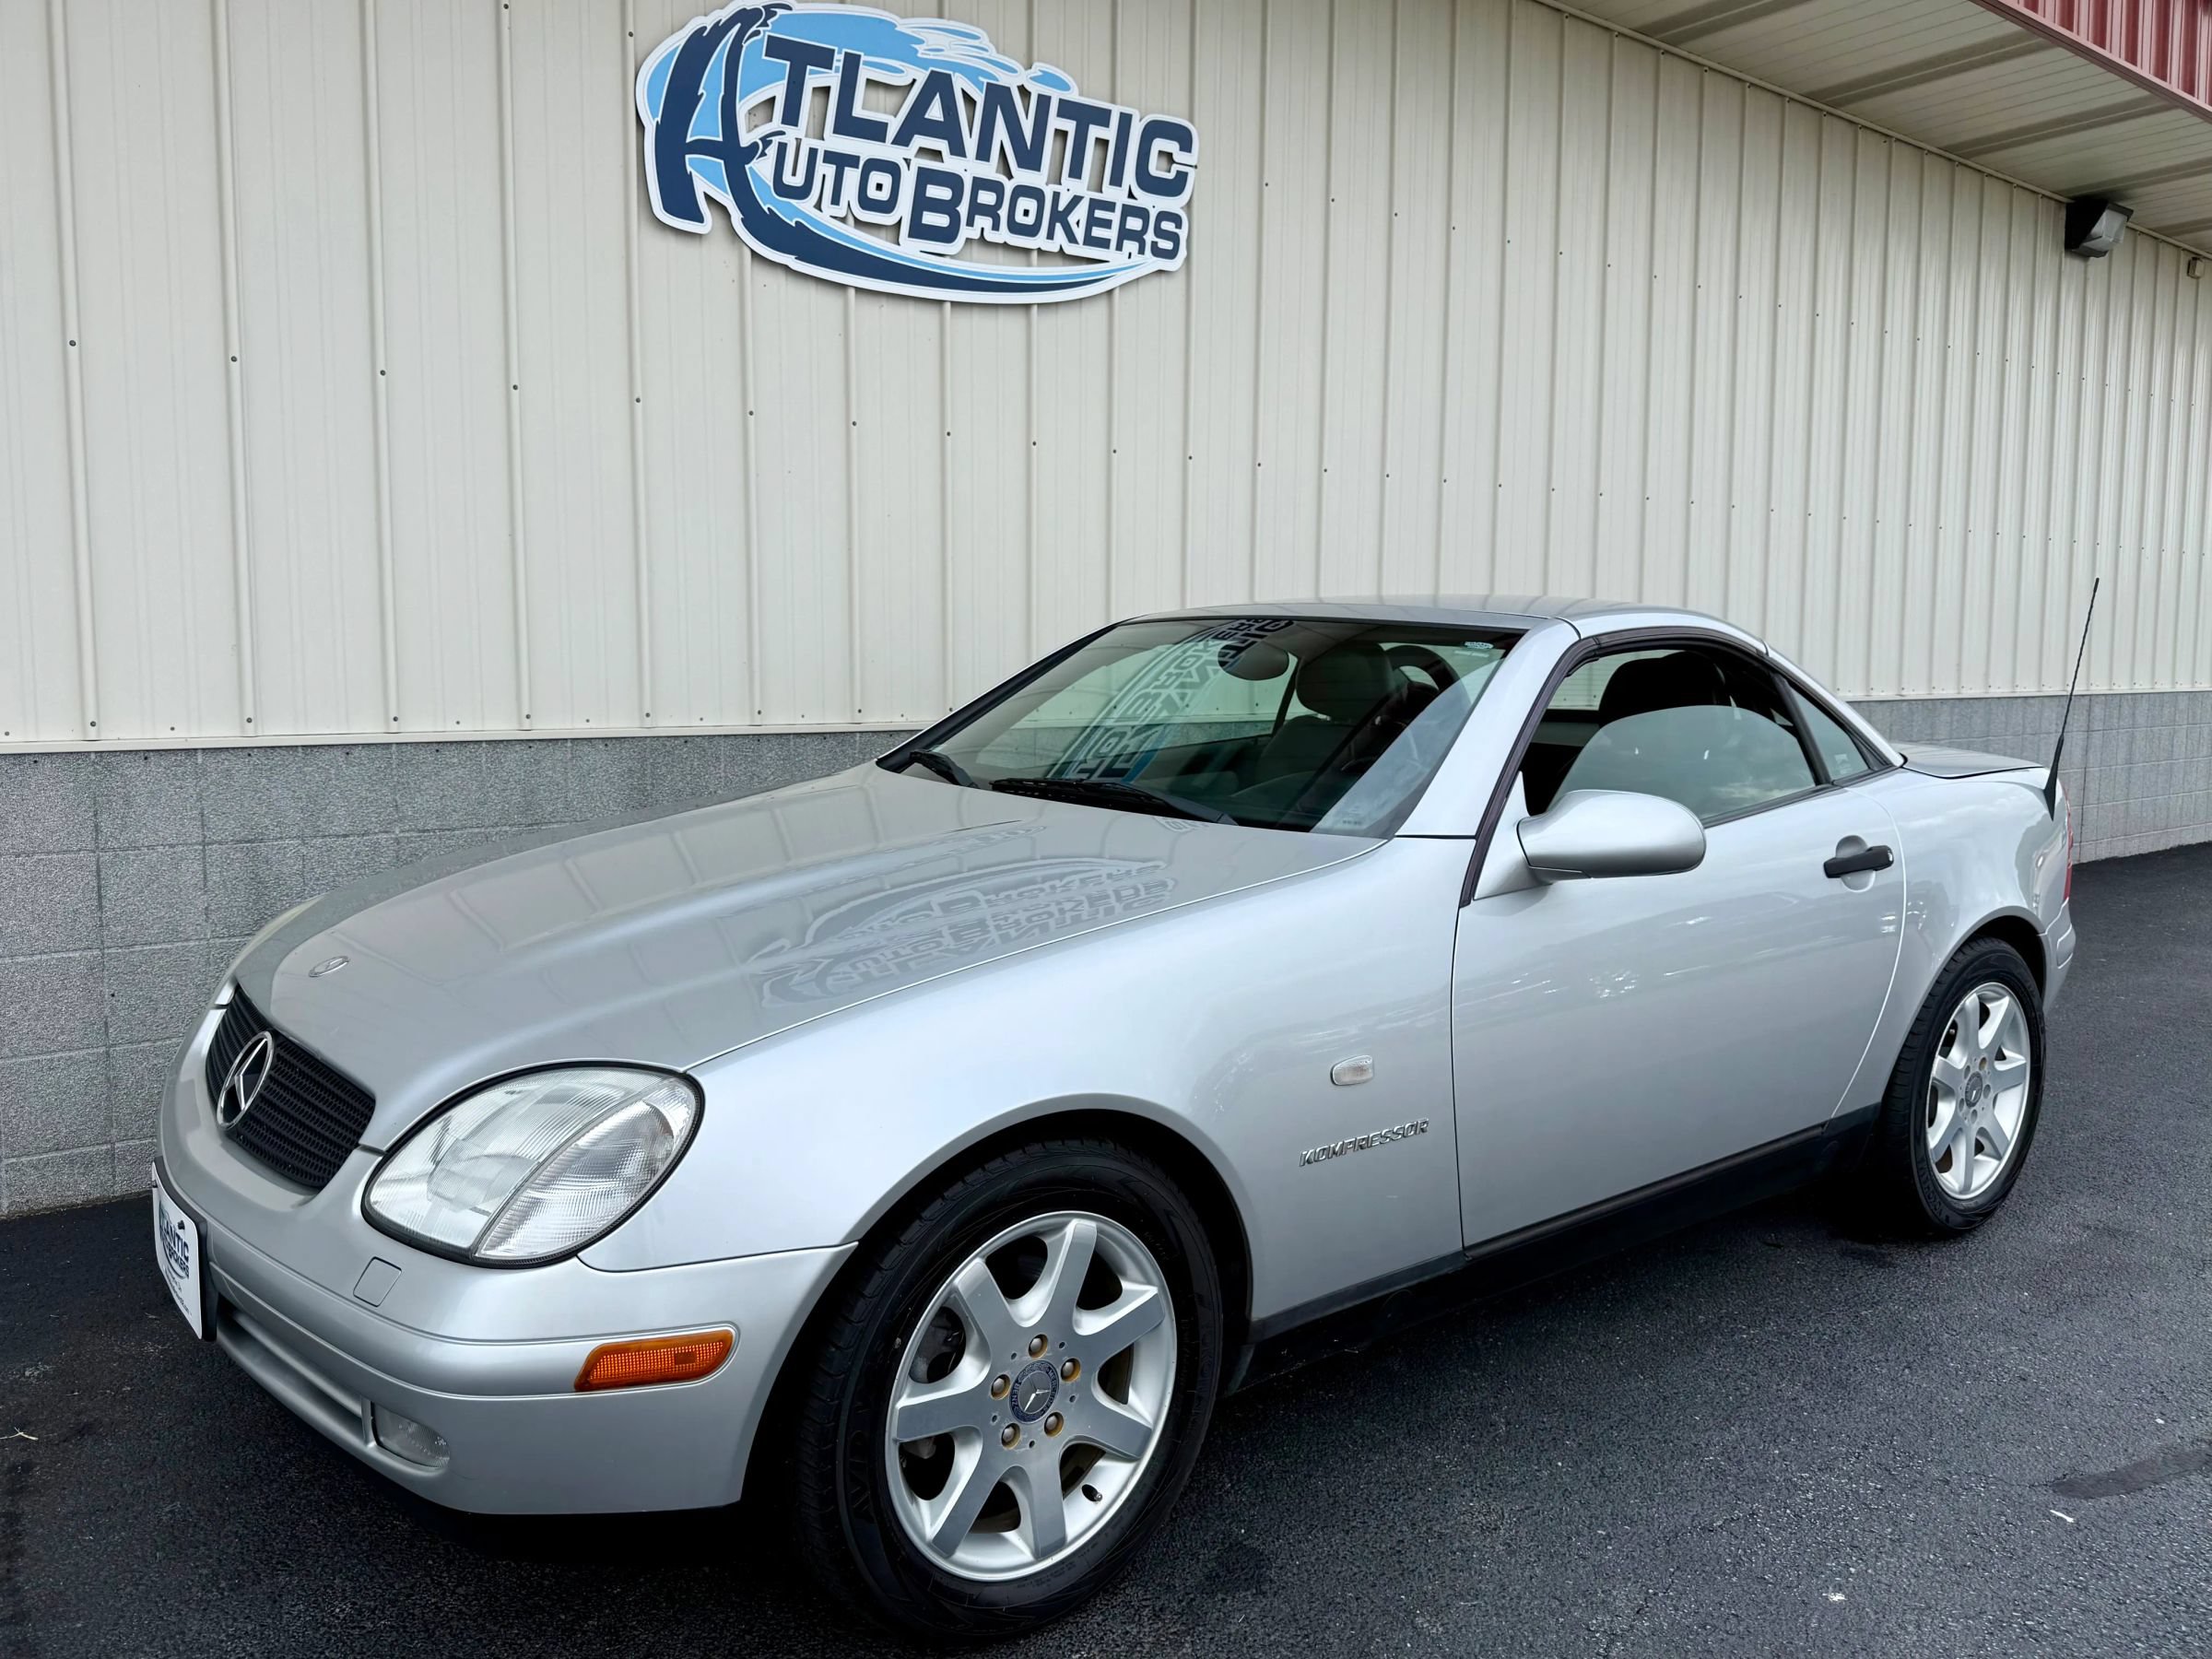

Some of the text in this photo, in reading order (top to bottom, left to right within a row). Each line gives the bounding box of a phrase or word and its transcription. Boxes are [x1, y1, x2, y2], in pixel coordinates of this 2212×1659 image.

[653, 3, 1194, 225] ATLANTIC
[908, 164, 1184, 260] BROKERS
[1300, 1118, 1429, 1167] KOMPRESSOR
